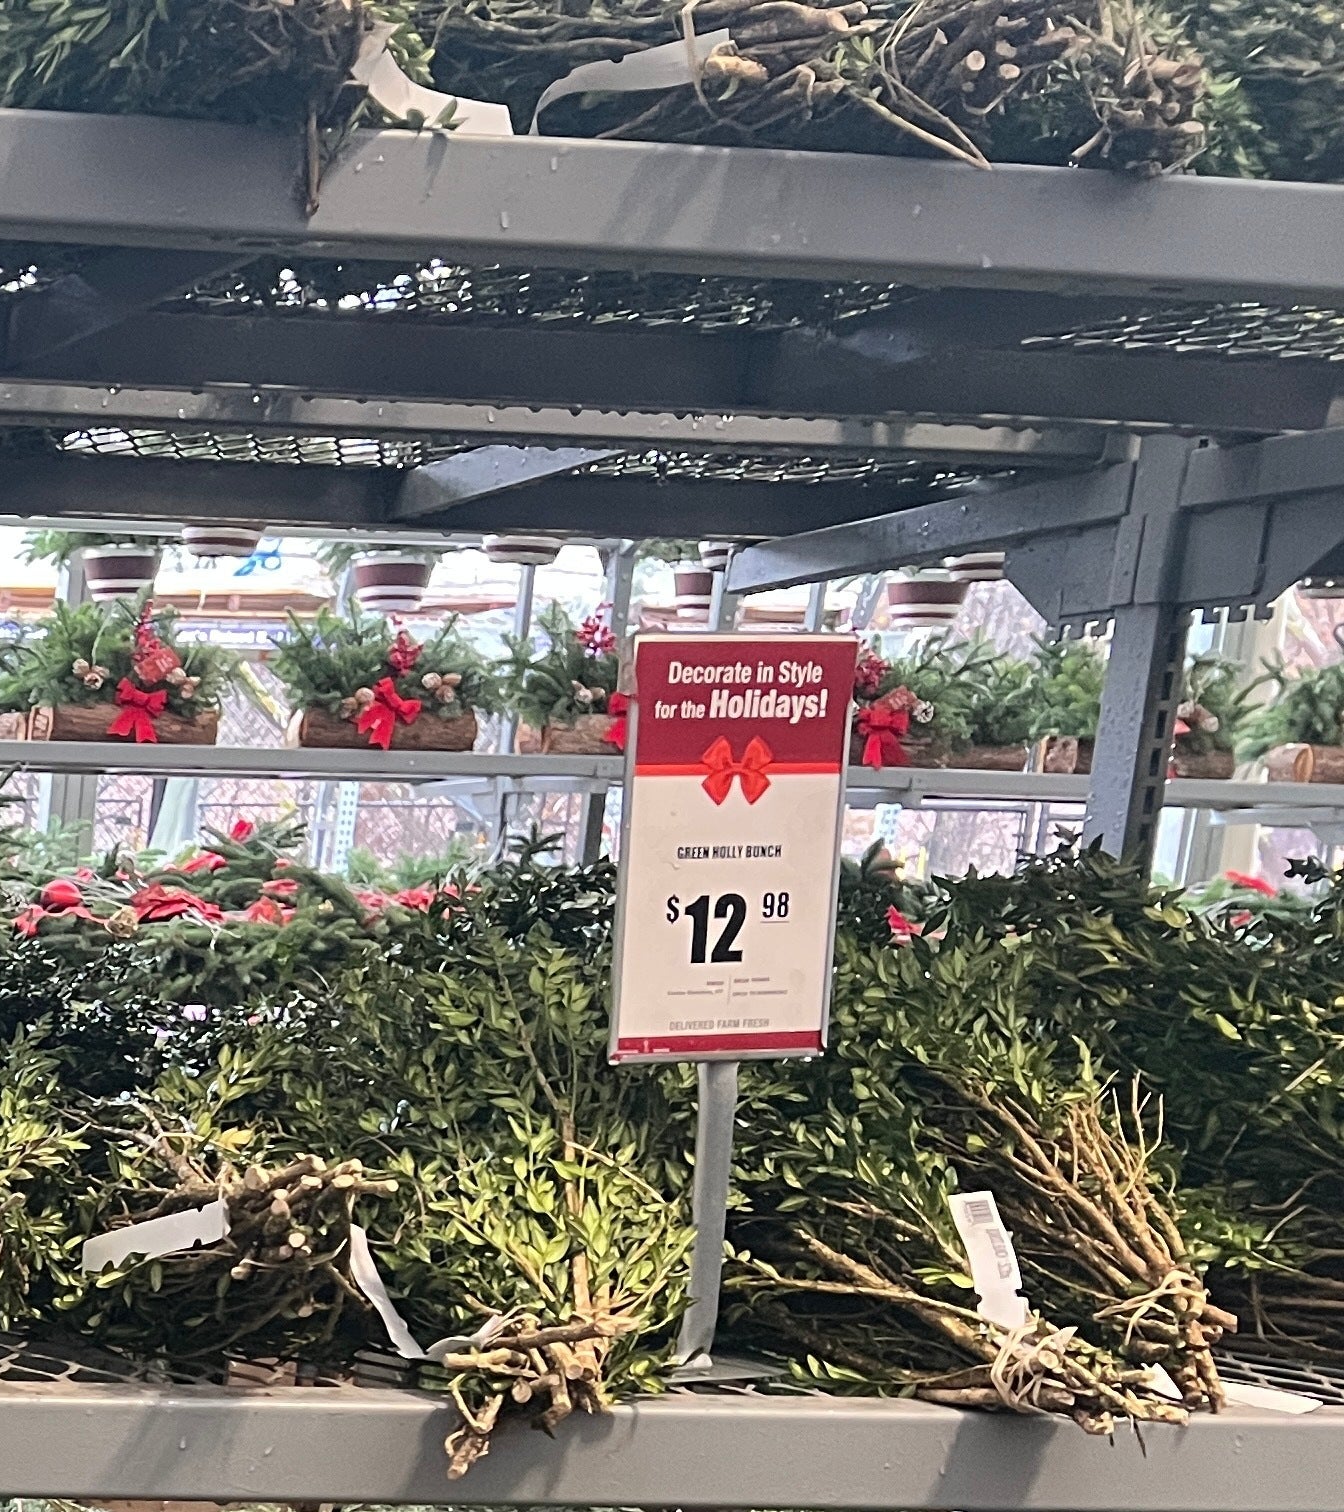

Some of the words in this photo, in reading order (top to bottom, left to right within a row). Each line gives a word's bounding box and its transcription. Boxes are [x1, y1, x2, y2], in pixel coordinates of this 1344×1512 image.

[668, 661, 752, 684] Decorate
[756, 661, 774, 684] in
[778, 660, 823, 688] Style
[654, 700, 678, 719] for
[680, 700, 706, 719] the
[709, 688, 828, 724] Holidays!
[677, 846, 710, 860] GREEN
[712, 845, 743, 859] HOLLY
[745, 844, 782, 858] BUNCH
[762, 892, 790, 918] 98
[668, 1019, 715, 1031] DELIVERED
[717, 1018, 740, 1030] FARM
[742, 1018, 770, 1029] FRESH
